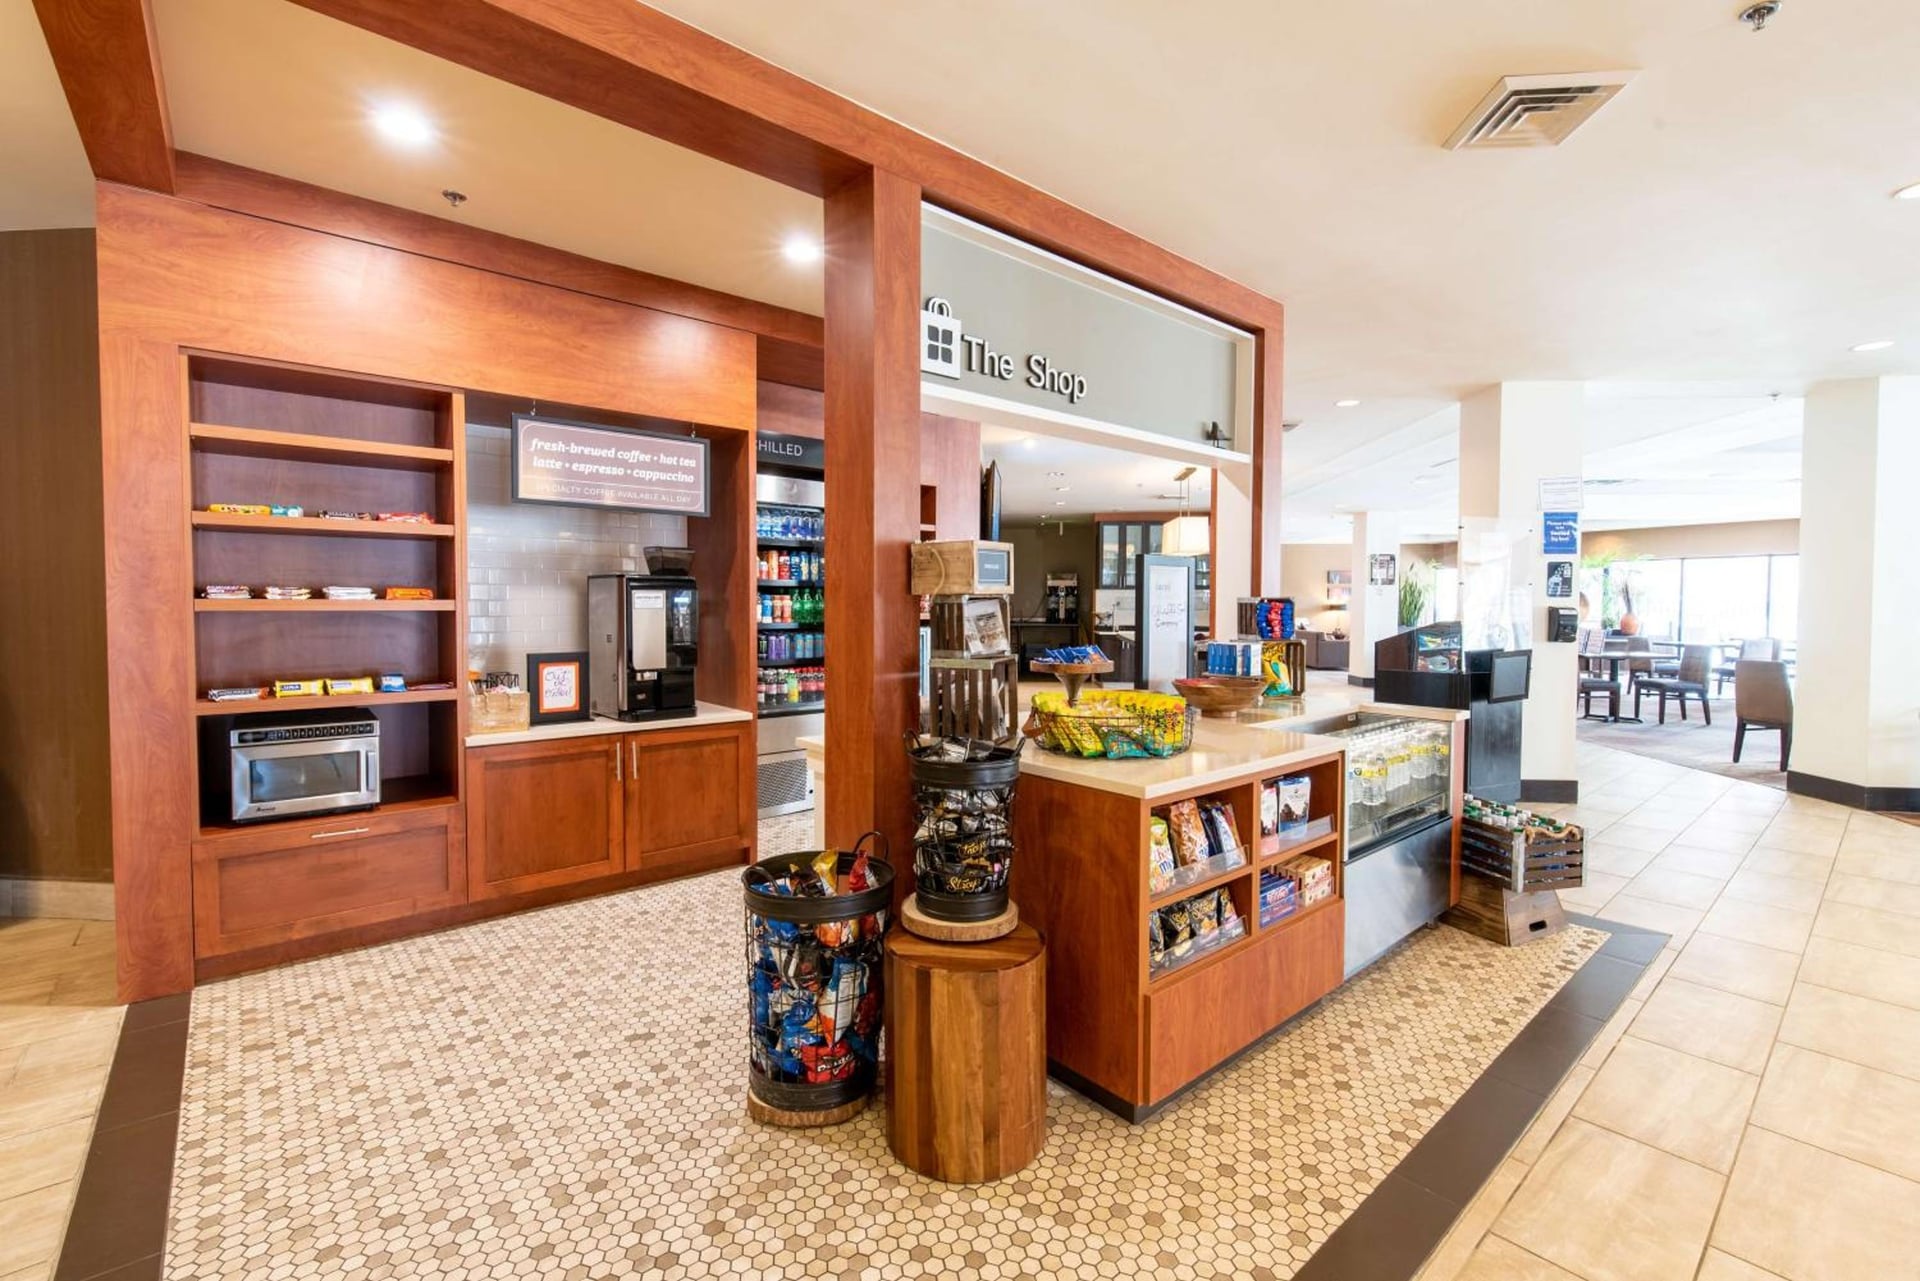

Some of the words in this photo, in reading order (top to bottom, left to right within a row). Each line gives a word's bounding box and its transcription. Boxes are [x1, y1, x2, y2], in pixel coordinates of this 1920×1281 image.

[961, 334, 1014, 380] The
[1025, 354, 1088, 404] Shop
[530, 438, 616, 458] fresh-brewed
[617, 449, 651, 464] coffee
[659, 453, 678, 466] hot
[679, 456, 697, 468] tea
[756, 439, 804, 457] HILLED
[532, 456, 563, 469] latte
[571, 462, 625, 476] espresso
[633, 468, 695, 483] cappuccino
